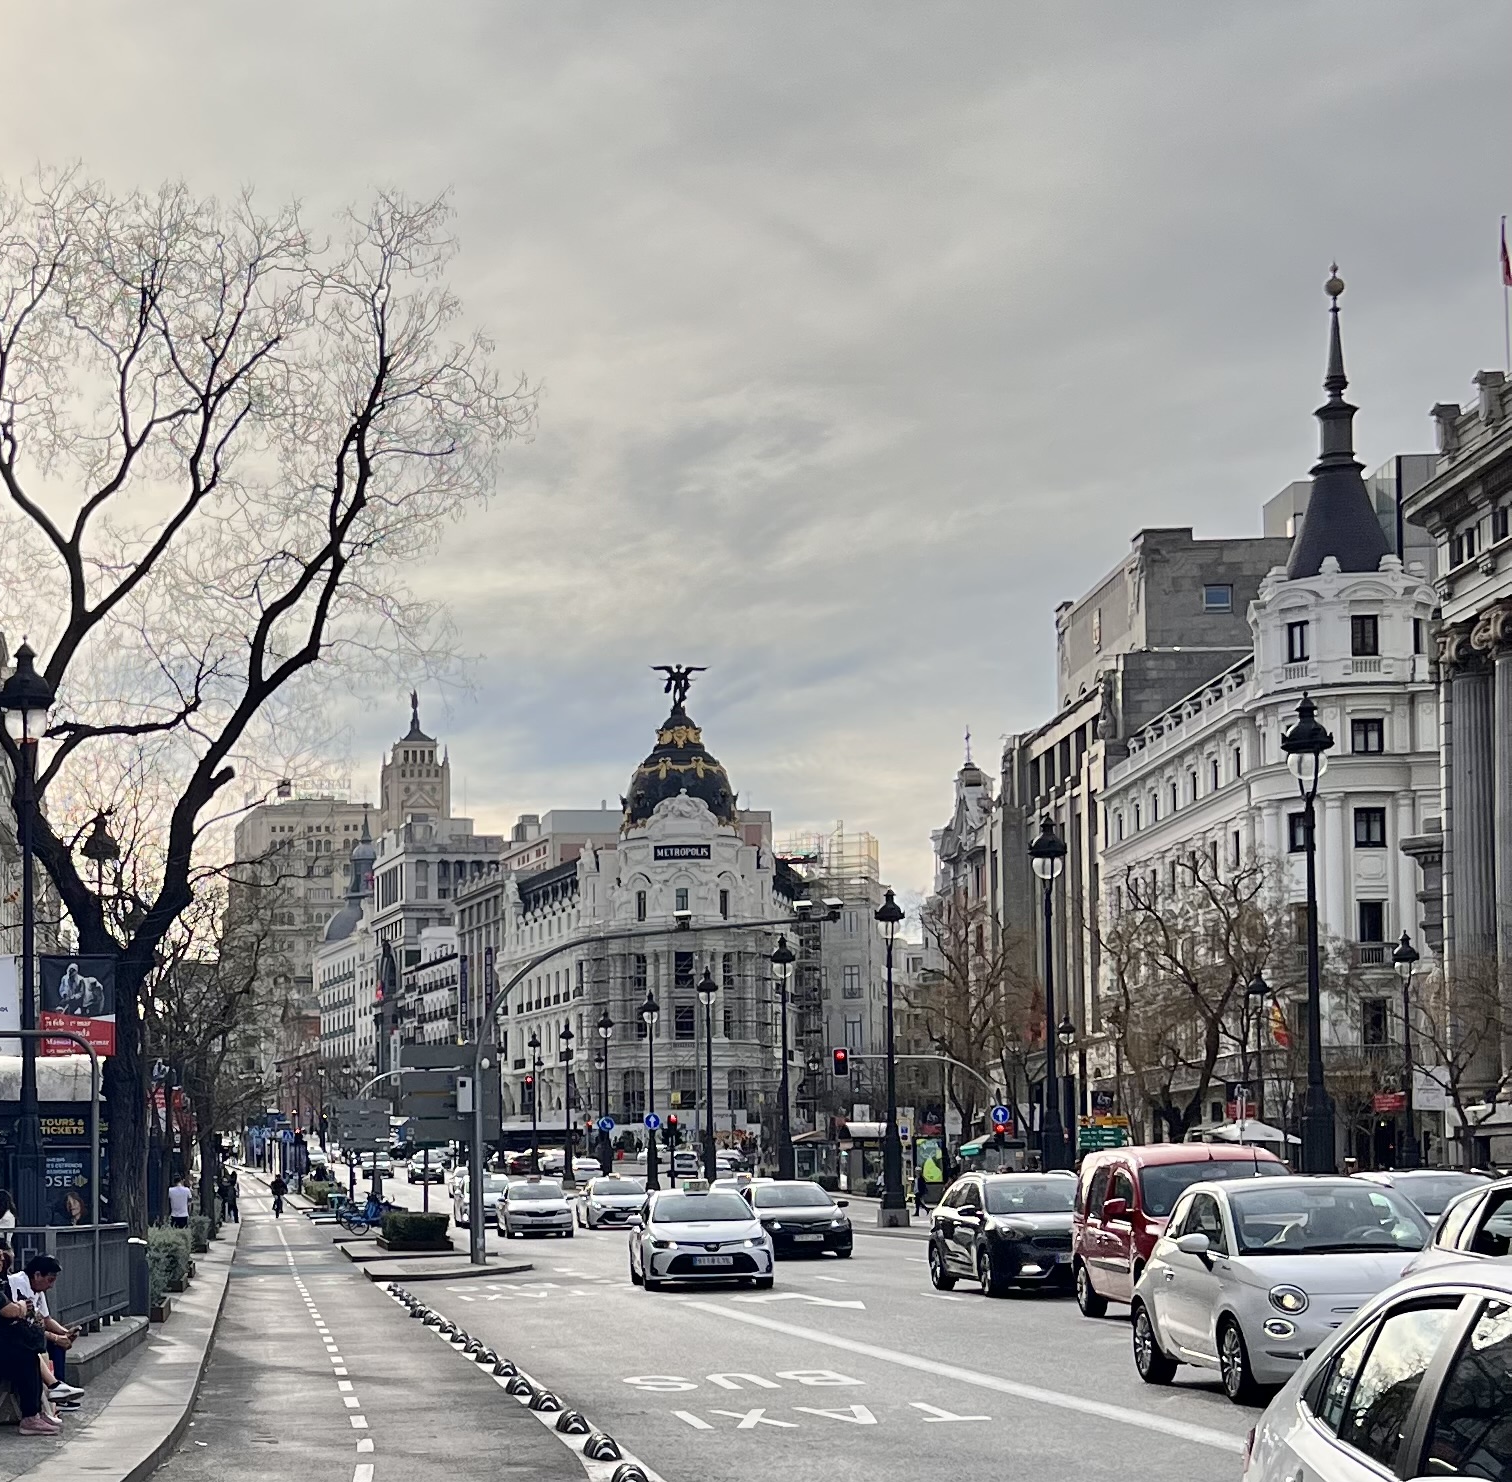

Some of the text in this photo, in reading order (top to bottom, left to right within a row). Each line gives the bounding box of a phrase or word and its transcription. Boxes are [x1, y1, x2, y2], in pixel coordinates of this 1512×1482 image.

[656, 847, 709, 858] METROPOLIS
[40, 1118, 75, 1127] TOURS
[40, 1126, 85, 1135] TICKETS
[622, 1369, 867, 1392] BUS
[669, 1402, 992, 1430] TAXI
